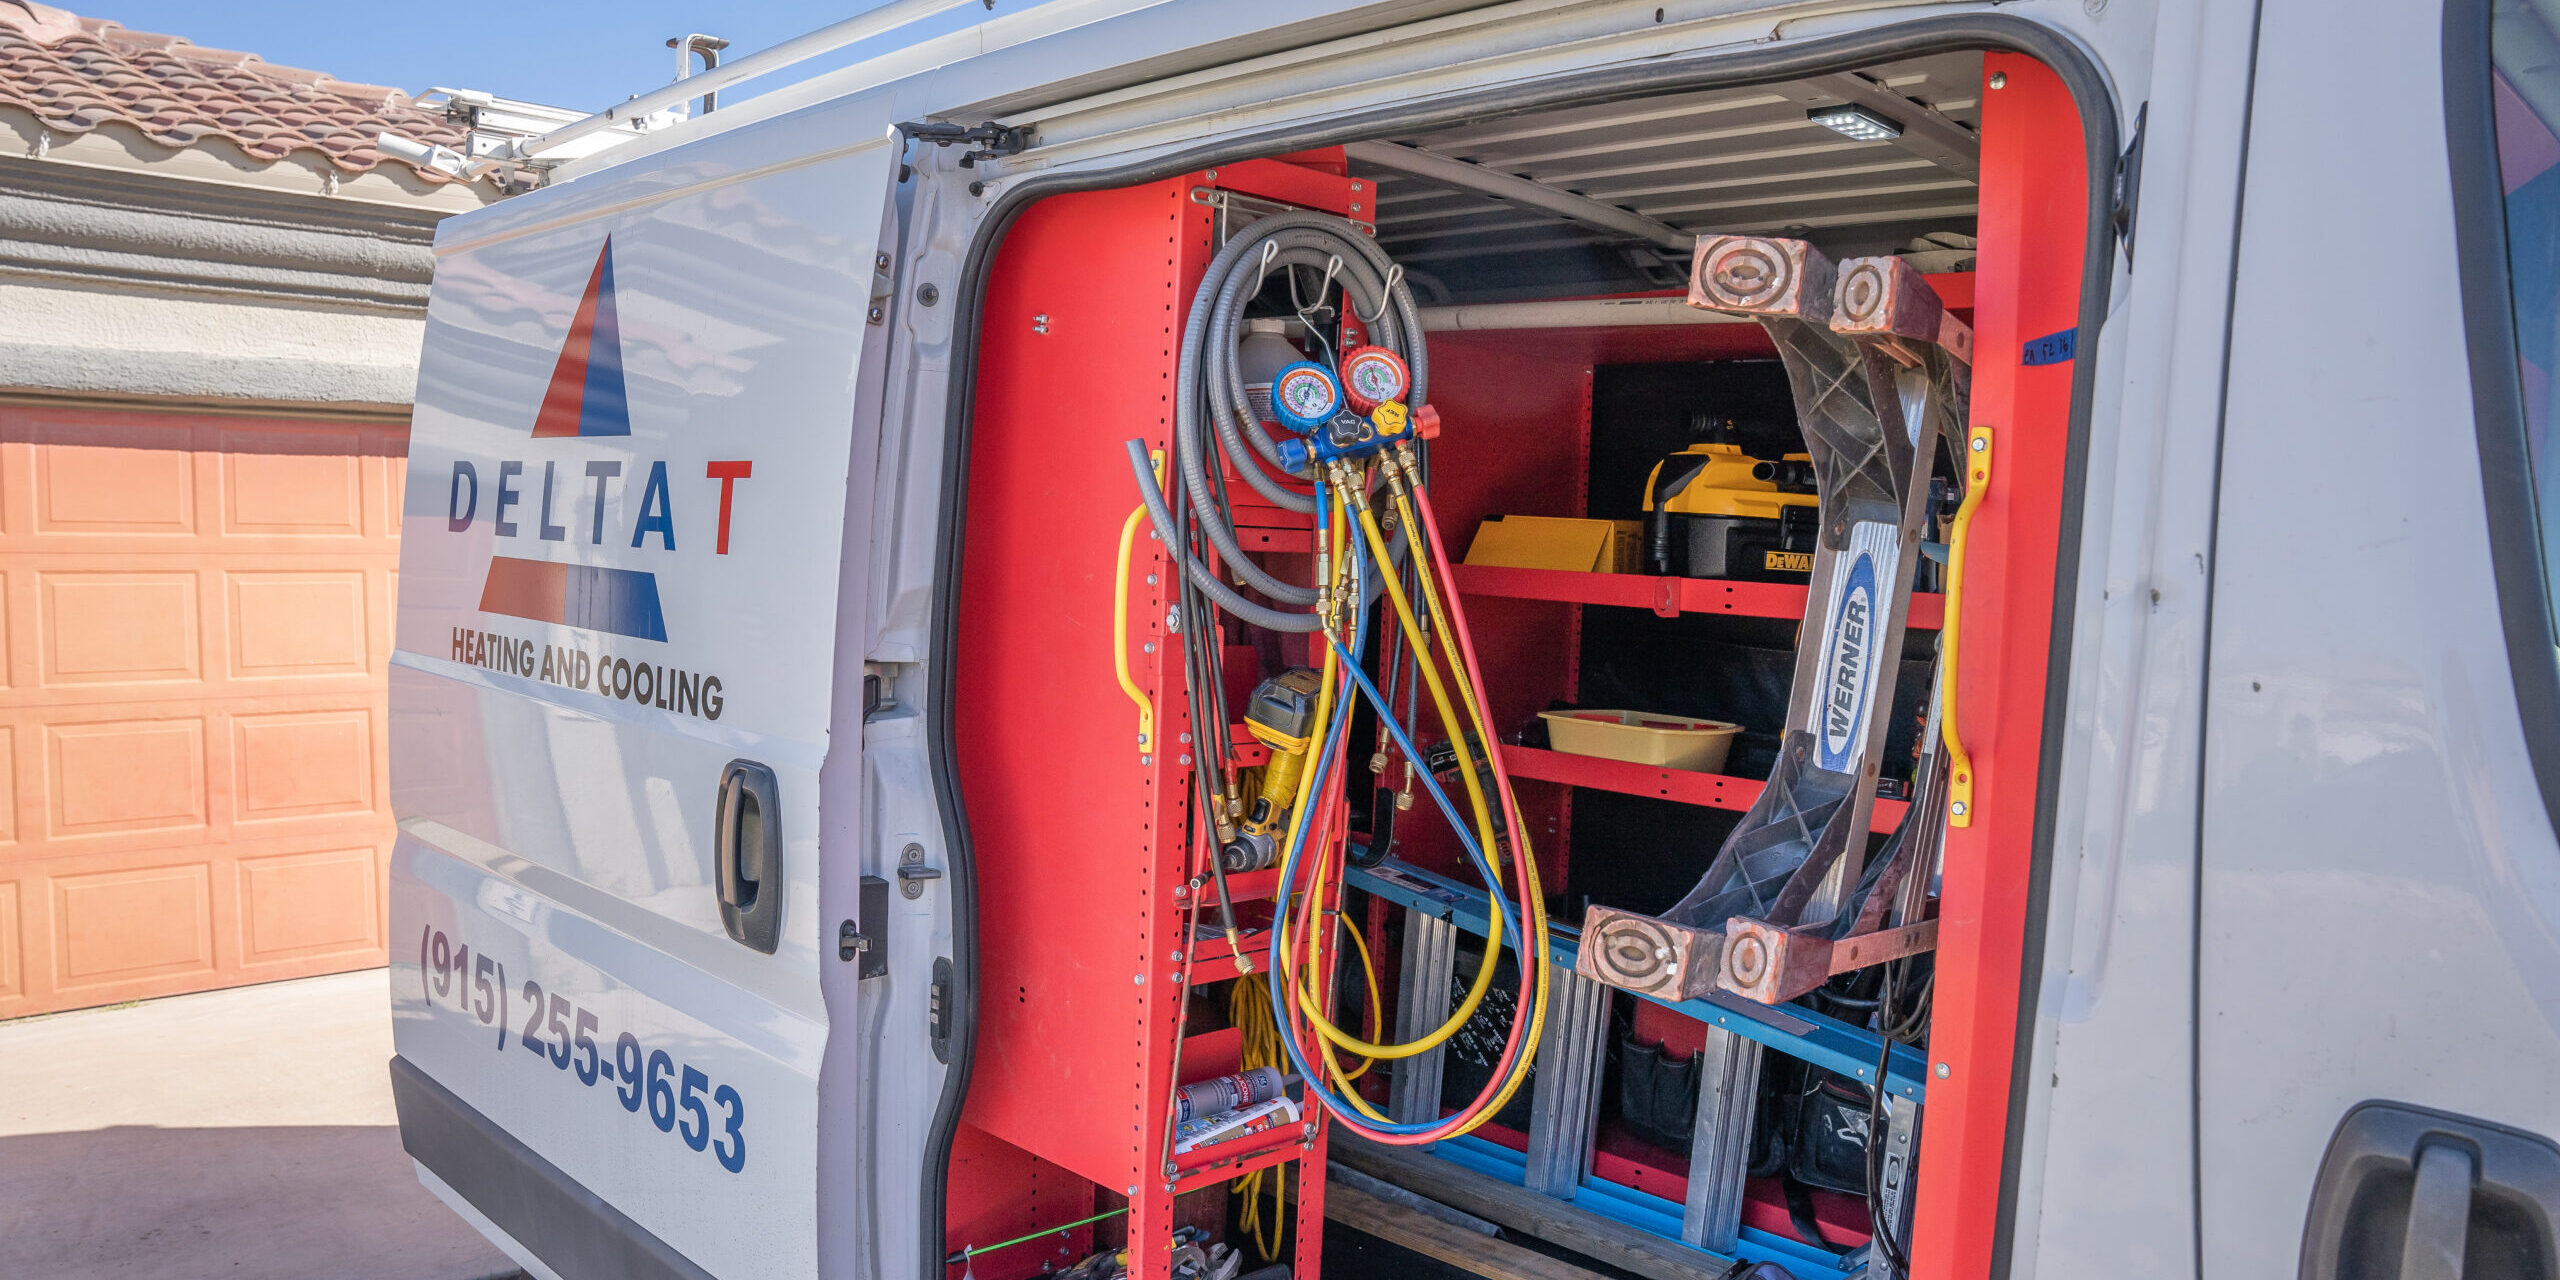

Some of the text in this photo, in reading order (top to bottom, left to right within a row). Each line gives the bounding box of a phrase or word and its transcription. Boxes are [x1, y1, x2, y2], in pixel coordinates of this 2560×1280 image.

[448, 460, 753, 555] DELTA T
[1766, 553, 1815, 569] DEWA
[451, 626, 724, 721] HEATING AND COOLING
[1829, 600, 1867, 738] WERNER
[421, 924, 746, 1174] (915) 255-9653
